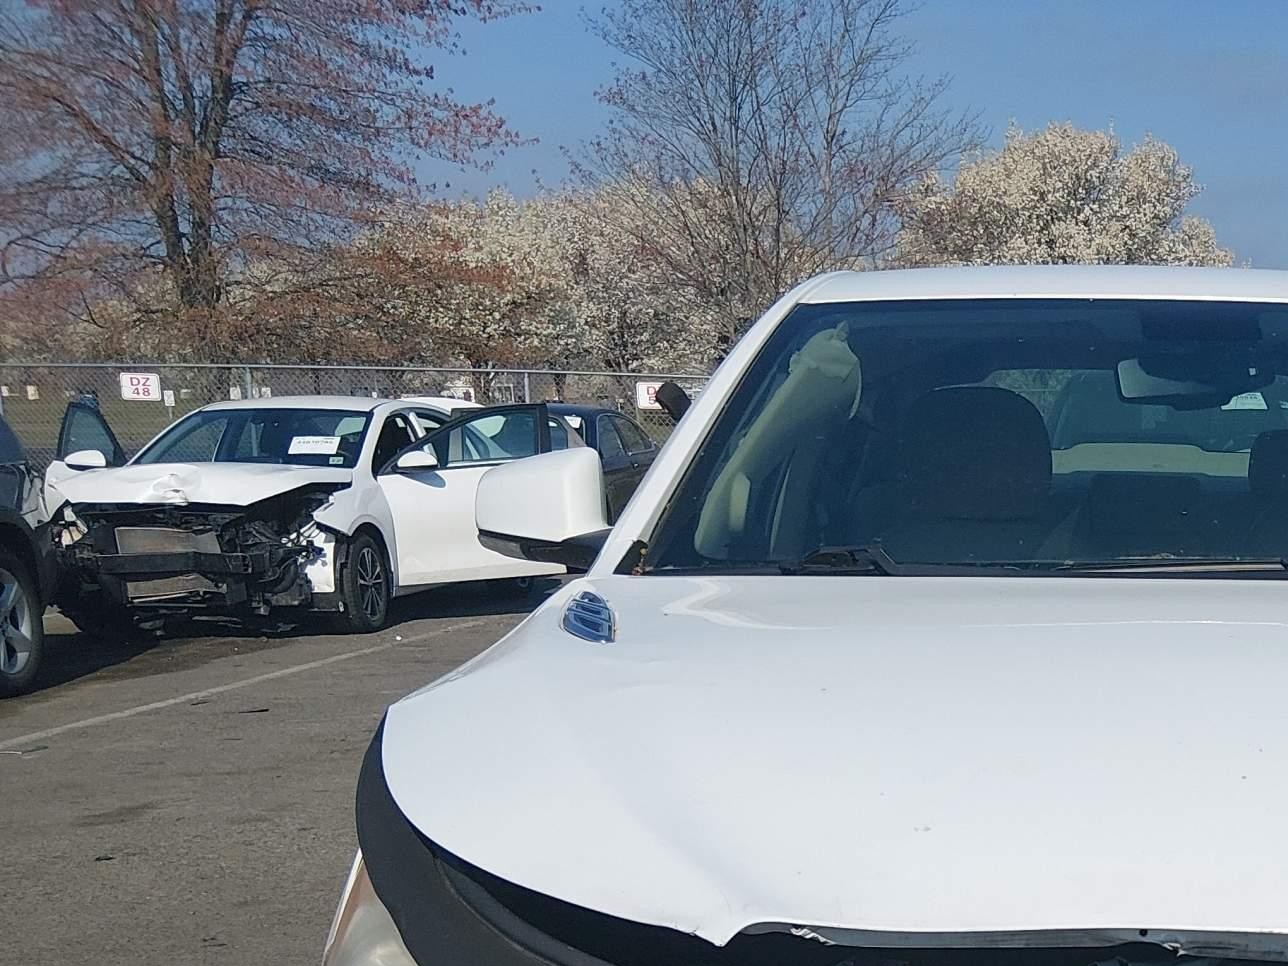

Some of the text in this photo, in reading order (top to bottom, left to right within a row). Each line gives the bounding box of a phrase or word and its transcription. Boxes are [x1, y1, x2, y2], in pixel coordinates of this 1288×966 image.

[129, 376, 152, 387] DZ
[132, 387, 151, 397] 48
[646, 386, 657, 396] D
